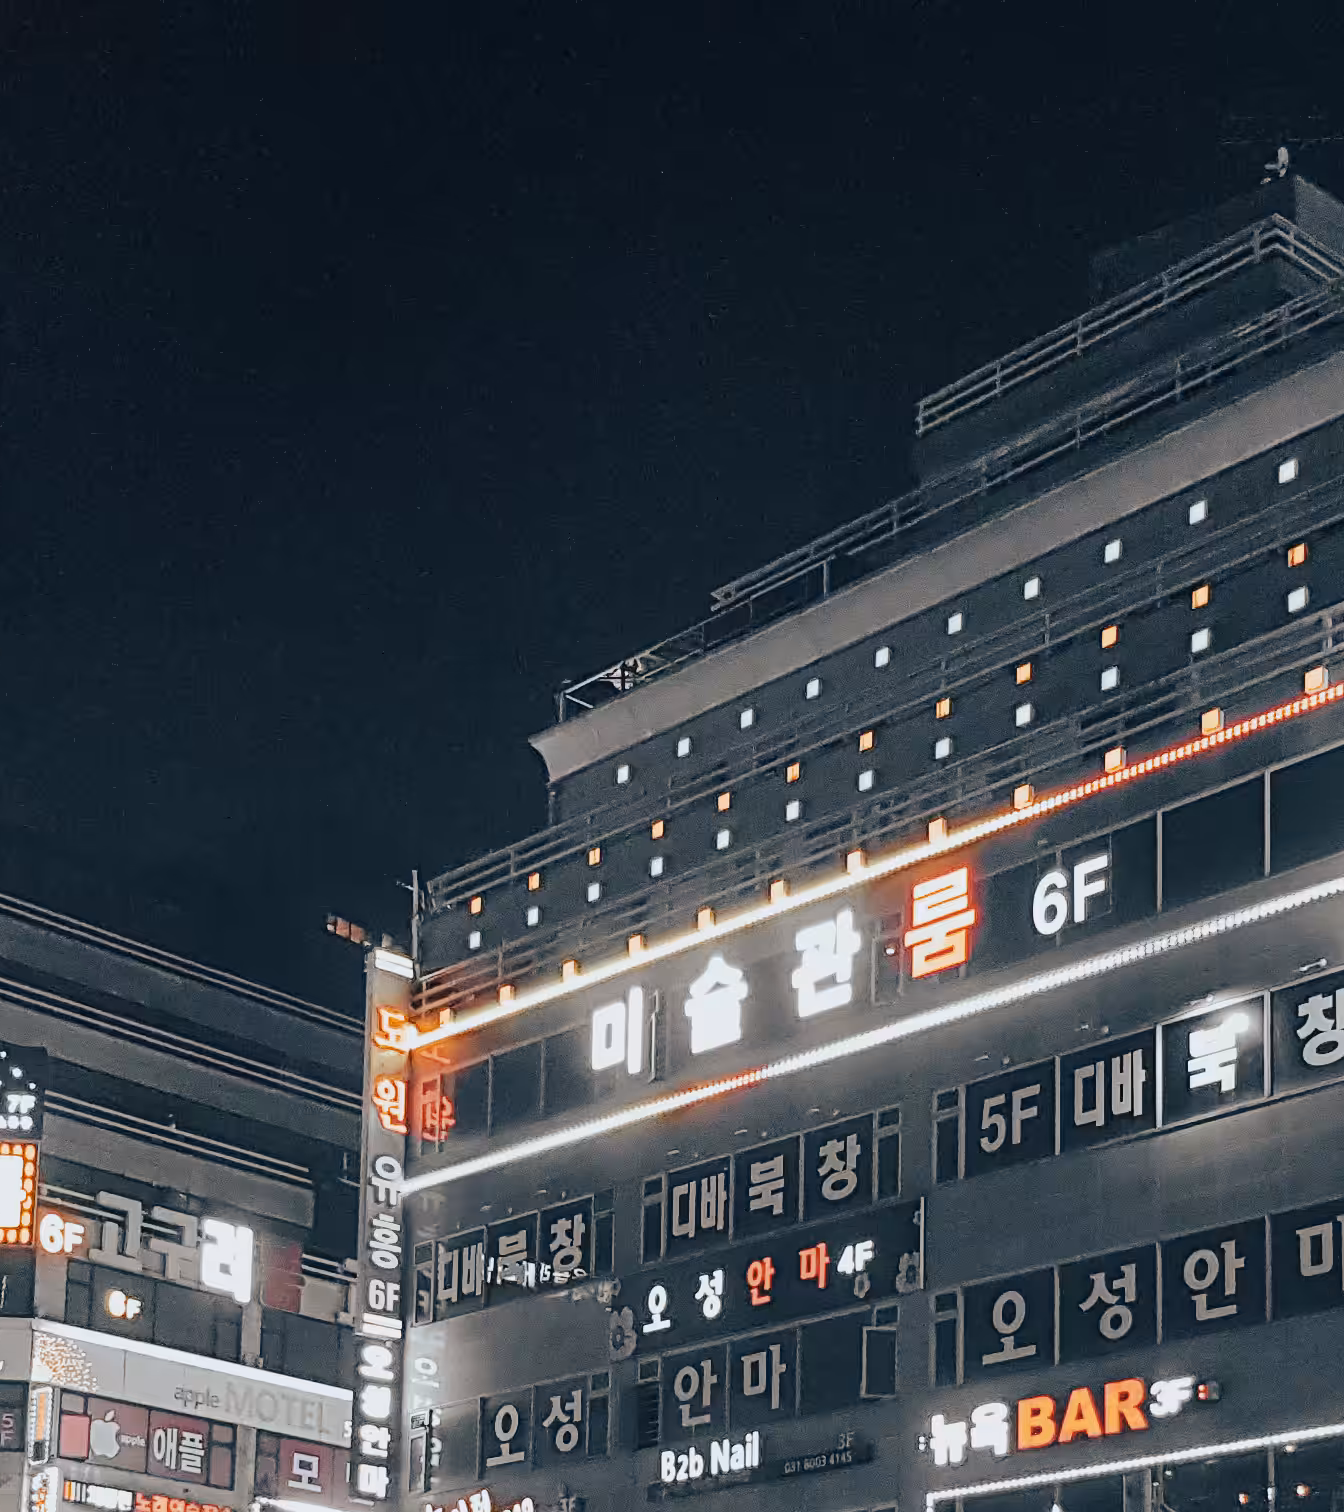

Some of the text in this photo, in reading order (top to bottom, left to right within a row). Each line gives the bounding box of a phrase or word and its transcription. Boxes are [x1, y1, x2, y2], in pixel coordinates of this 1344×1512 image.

[904, 866, 976, 980] 룸
[1032, 855, 1109, 936] 6F
[979, 1083, 1041, 1153] 5F
[38, 1213, 86, 1254] 6F
[368, 1278, 401, 1312] 6F
[642, 1243, 830, 1333] 오성안마
[1016, 1377, 1149, 1453] BAR
[152, 1426, 206, 1475] 애플
[660, 1446, 704, 1484] B2b
[709, 1431, 760, 1474] Nail
